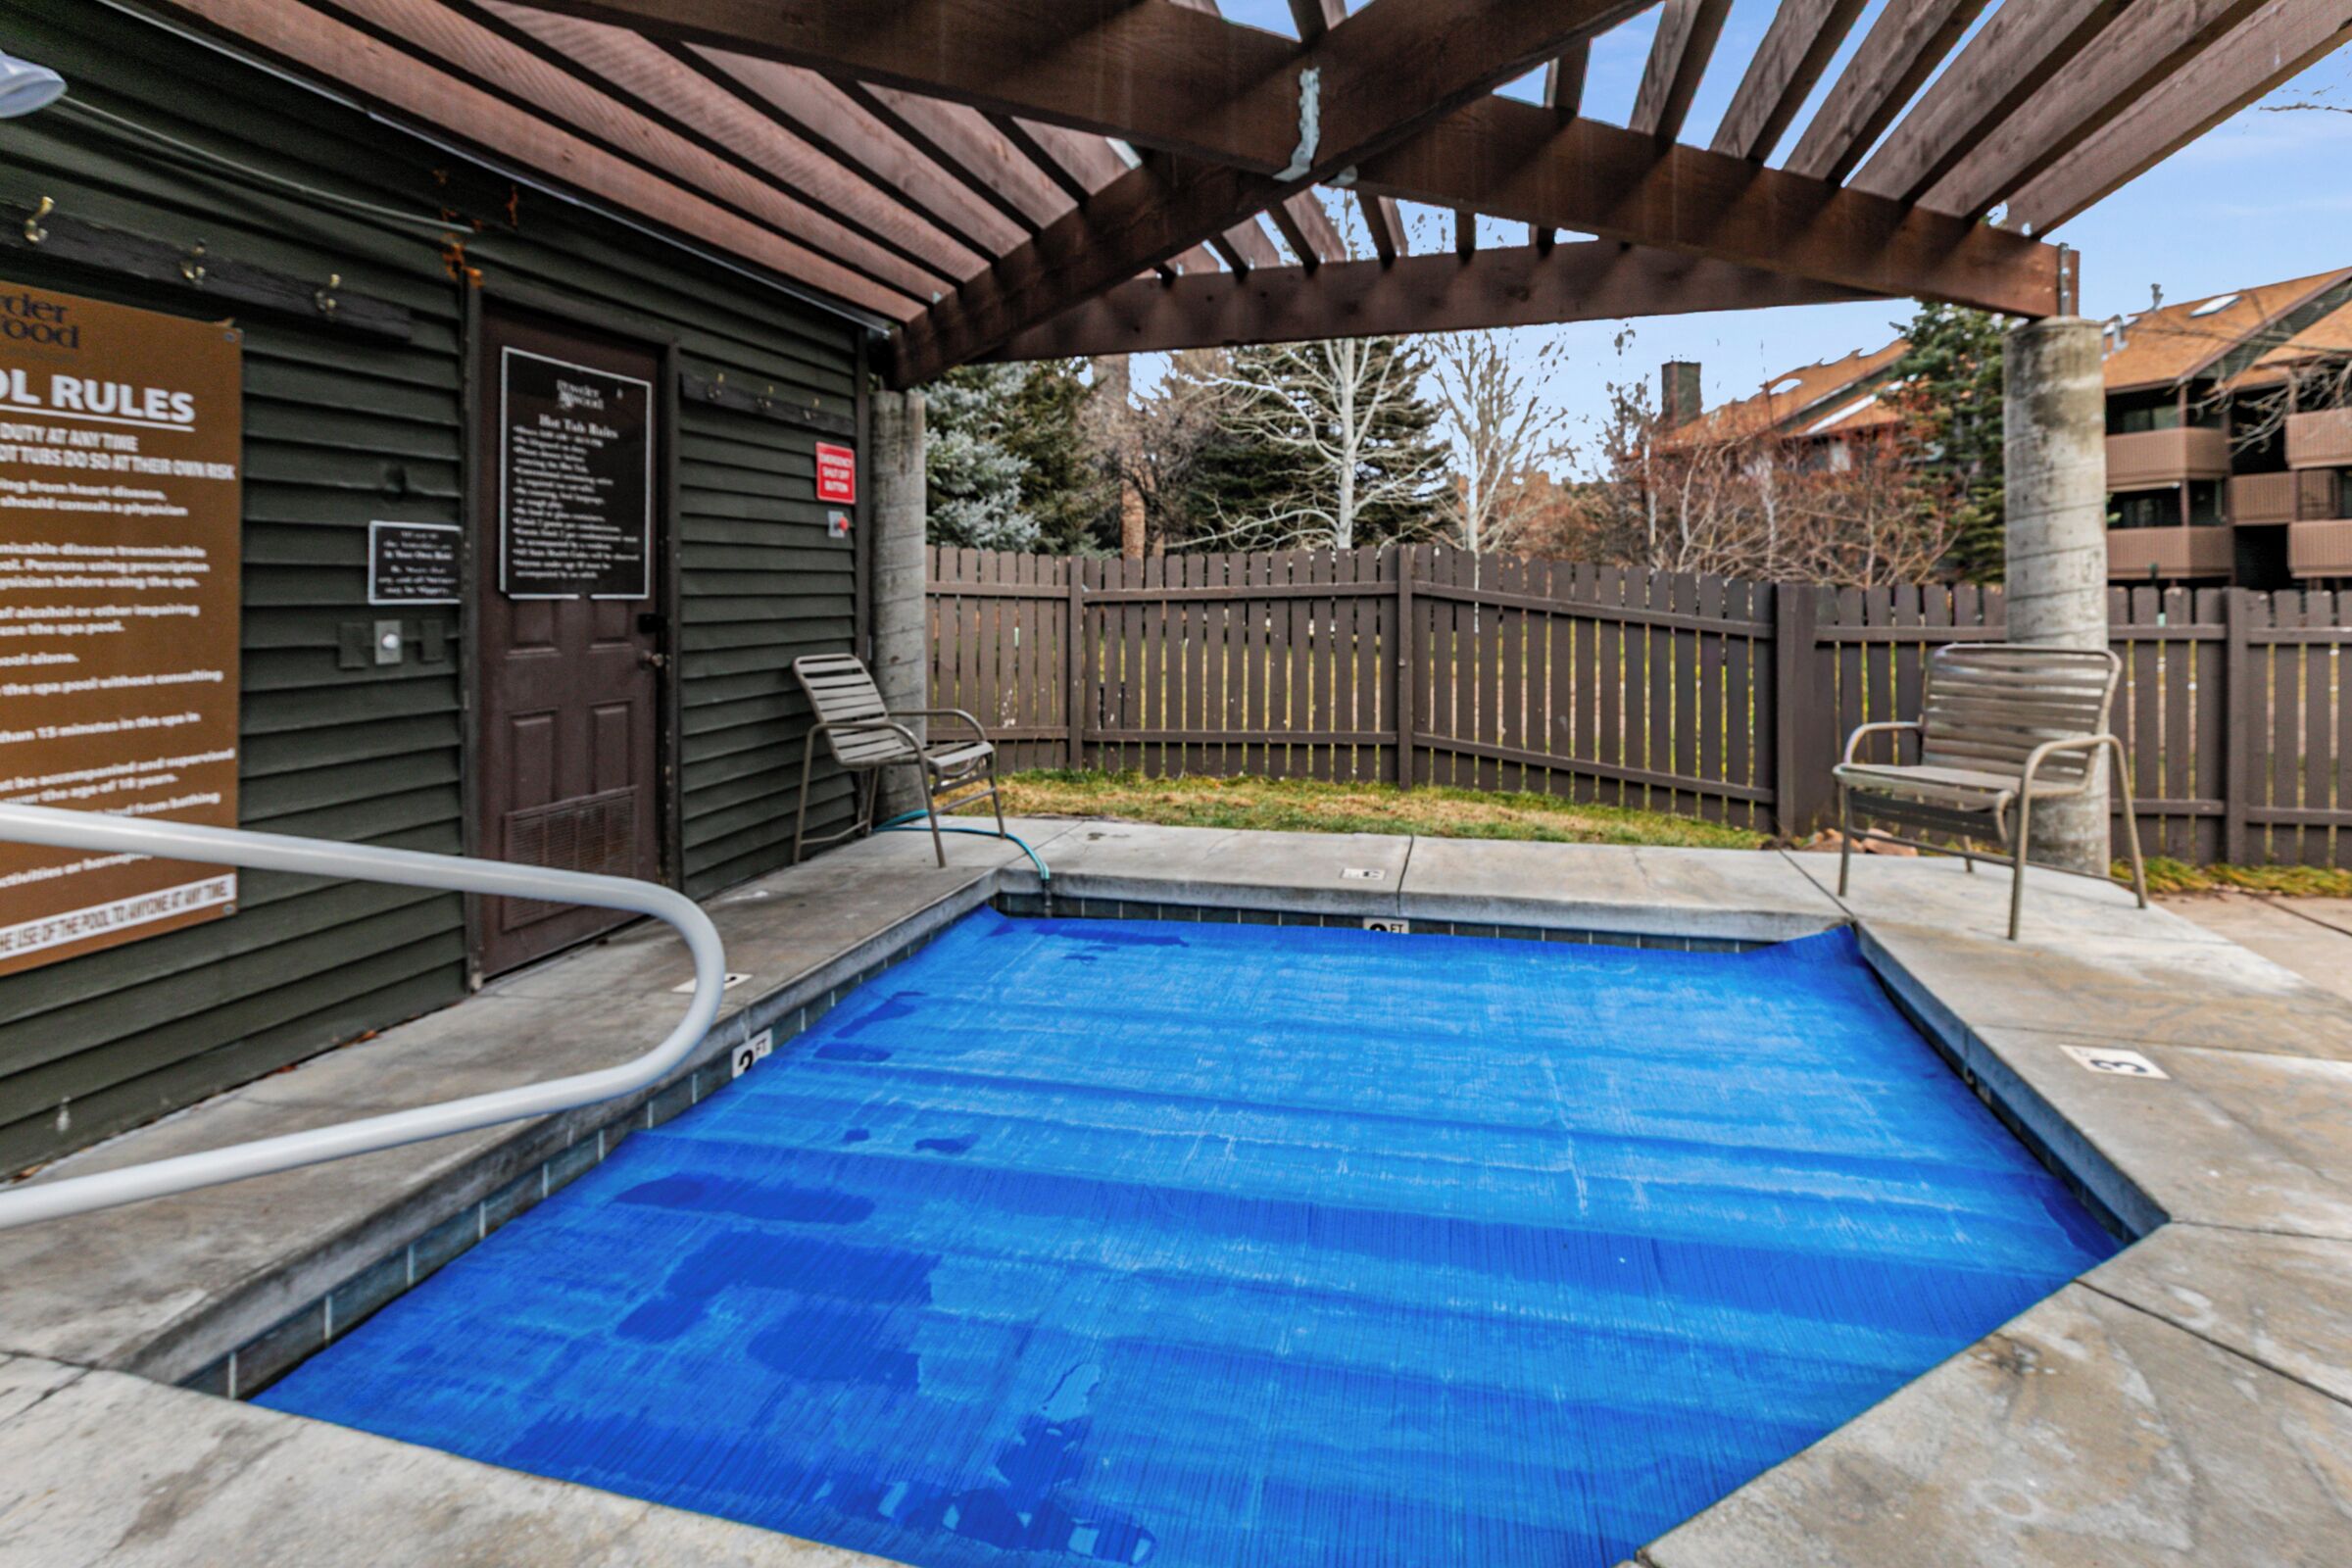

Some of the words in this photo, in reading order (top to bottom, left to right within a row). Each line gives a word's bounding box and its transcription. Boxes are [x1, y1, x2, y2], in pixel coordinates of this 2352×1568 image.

[0, 313, 78, 349] ood
[52, 374, 195, 423] RULES
[0, 421, 45, 443] DUTY
